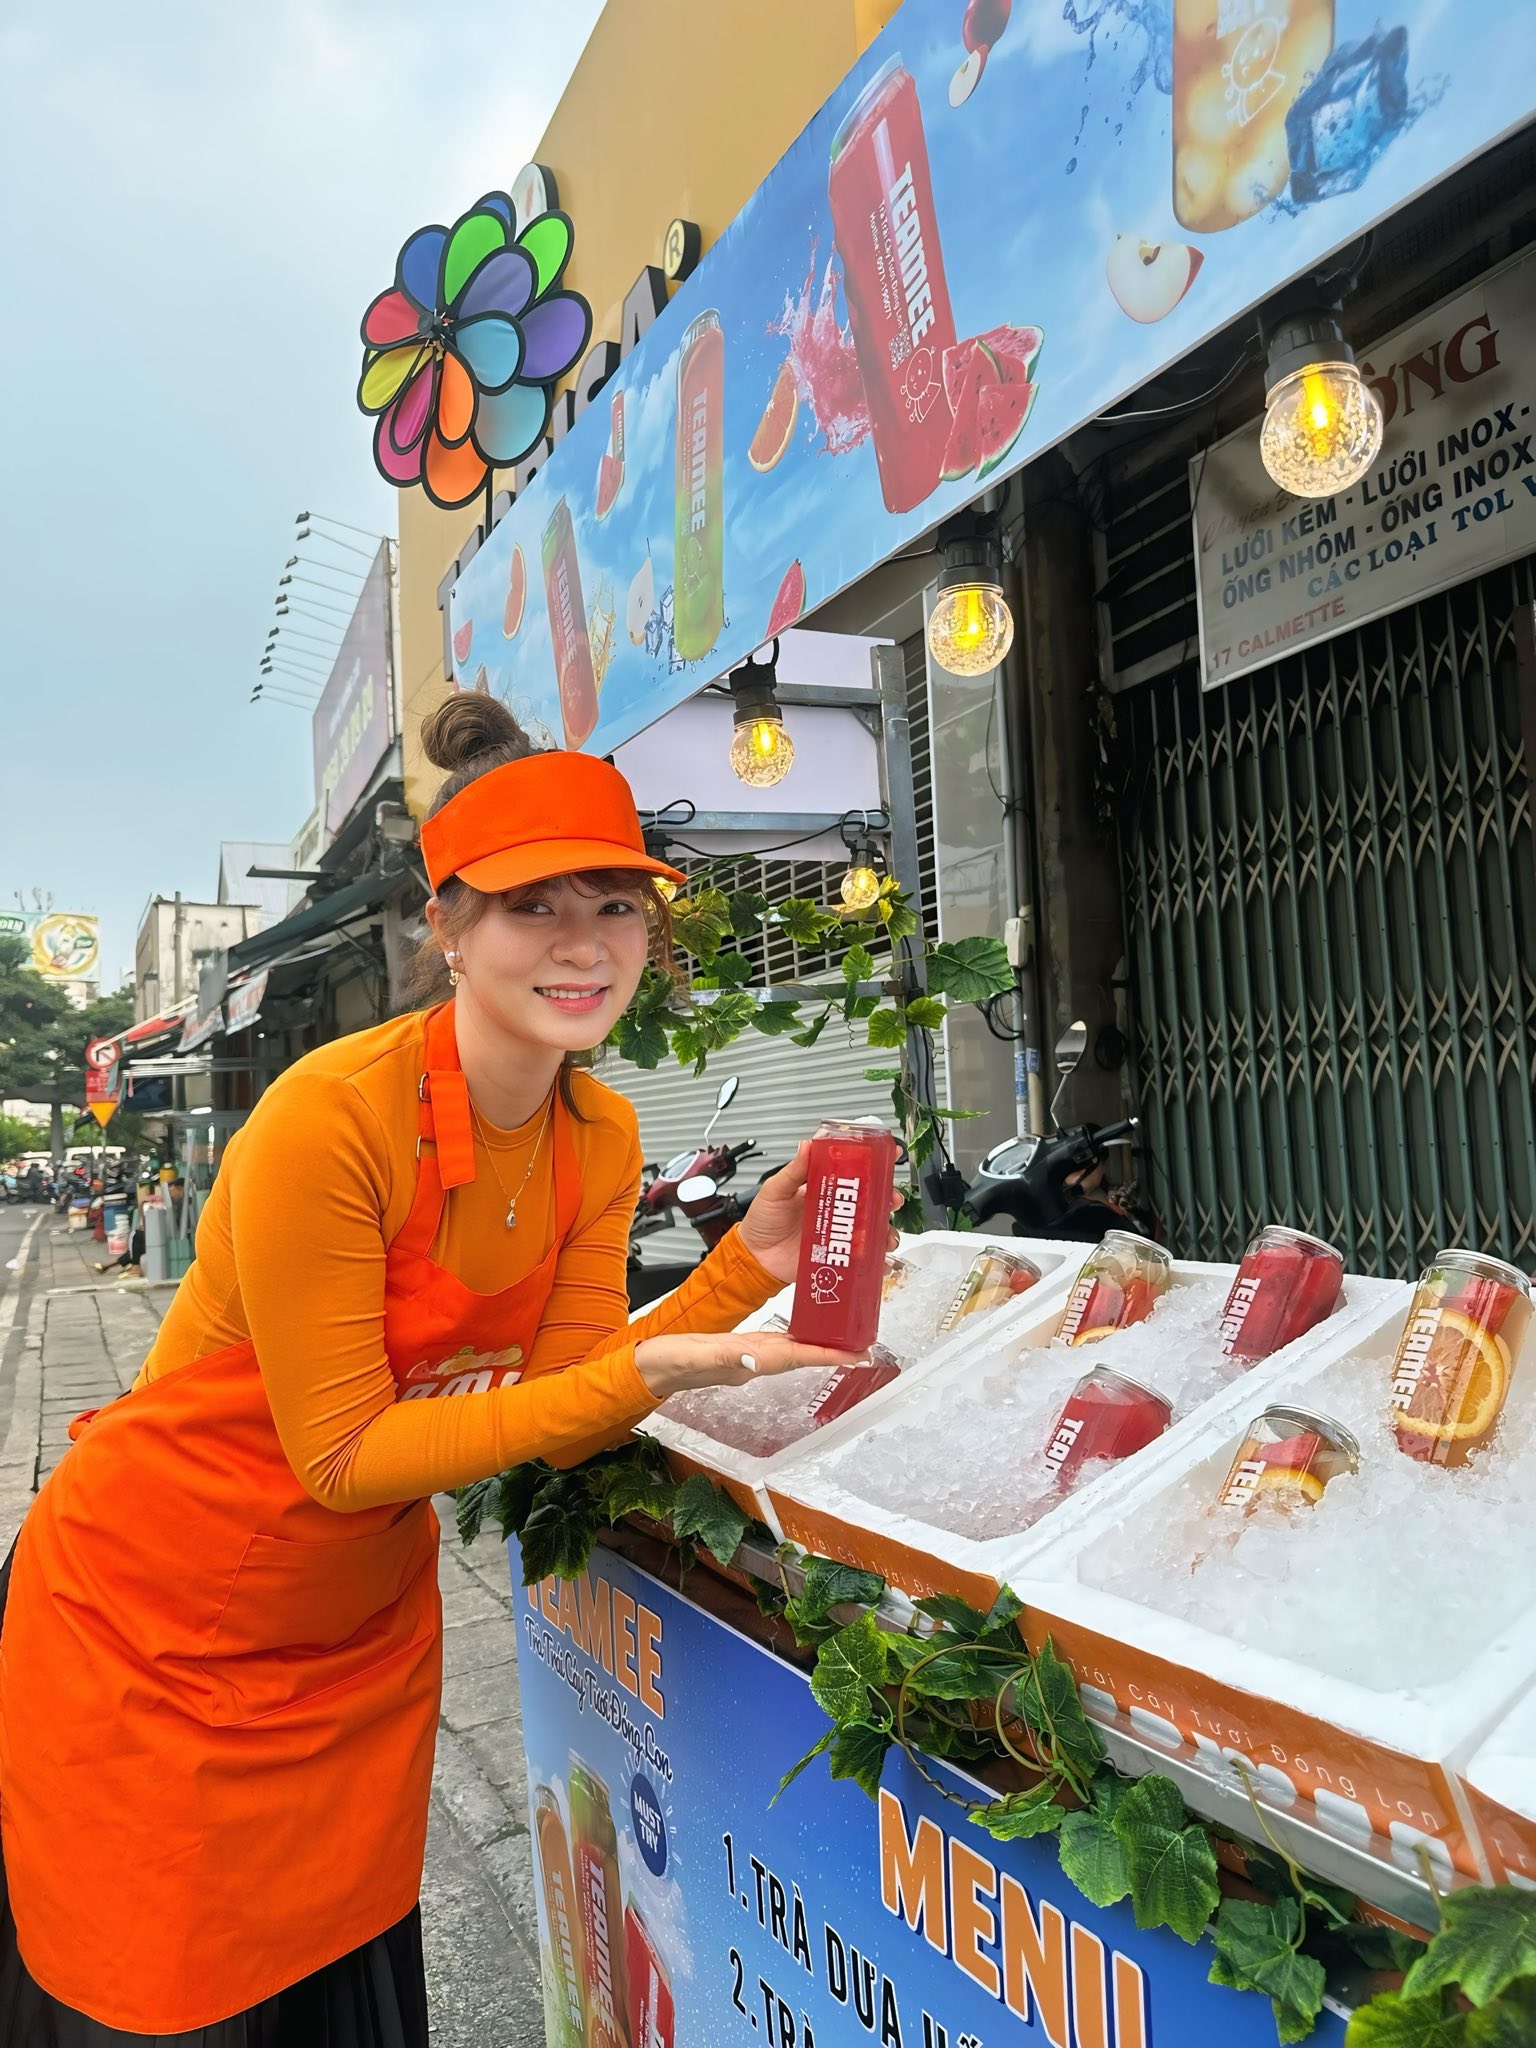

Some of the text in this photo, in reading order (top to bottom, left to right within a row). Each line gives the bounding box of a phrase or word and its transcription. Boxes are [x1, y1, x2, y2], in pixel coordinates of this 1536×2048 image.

[888, 161, 935, 349] TEAMEE
[691, 387, 708, 533] TEAMEE
[1222, 568, 1273, 610] ỐNG
[1279, 527, 1356, 585] NHÔM
[1381, 483, 1444, 533] ỐNG
[1454, 434, 1535, 499] INOX
[1281, 497, 1338, 546] KẼM
[1307, 487, 1514, 600] CÁC LOẠI TOL
[1212, 597, 1346, 670] 17 CALMETTE
[827, 1177, 860, 1268] TEAMEE
[936, 1283, 972, 1337] TEAM
[1391, 1307, 1443, 1410] TEAMEE
[634, 1790, 661, 1835] MUST
[1190, 1709, 1254, 1750] Tươi
[1269, 1743, 1357, 1800] Đóng
[1375, 1786, 1441, 1831] Lon
[639, 1818, 658, 1854] TRY
[552, 1870, 584, 2034] TEAMEE
[590, 1857, 617, 2045] TEAMEE
[879, 1786, 1147, 2048] MENU
[824, 1920, 905, 2048] DƯA
